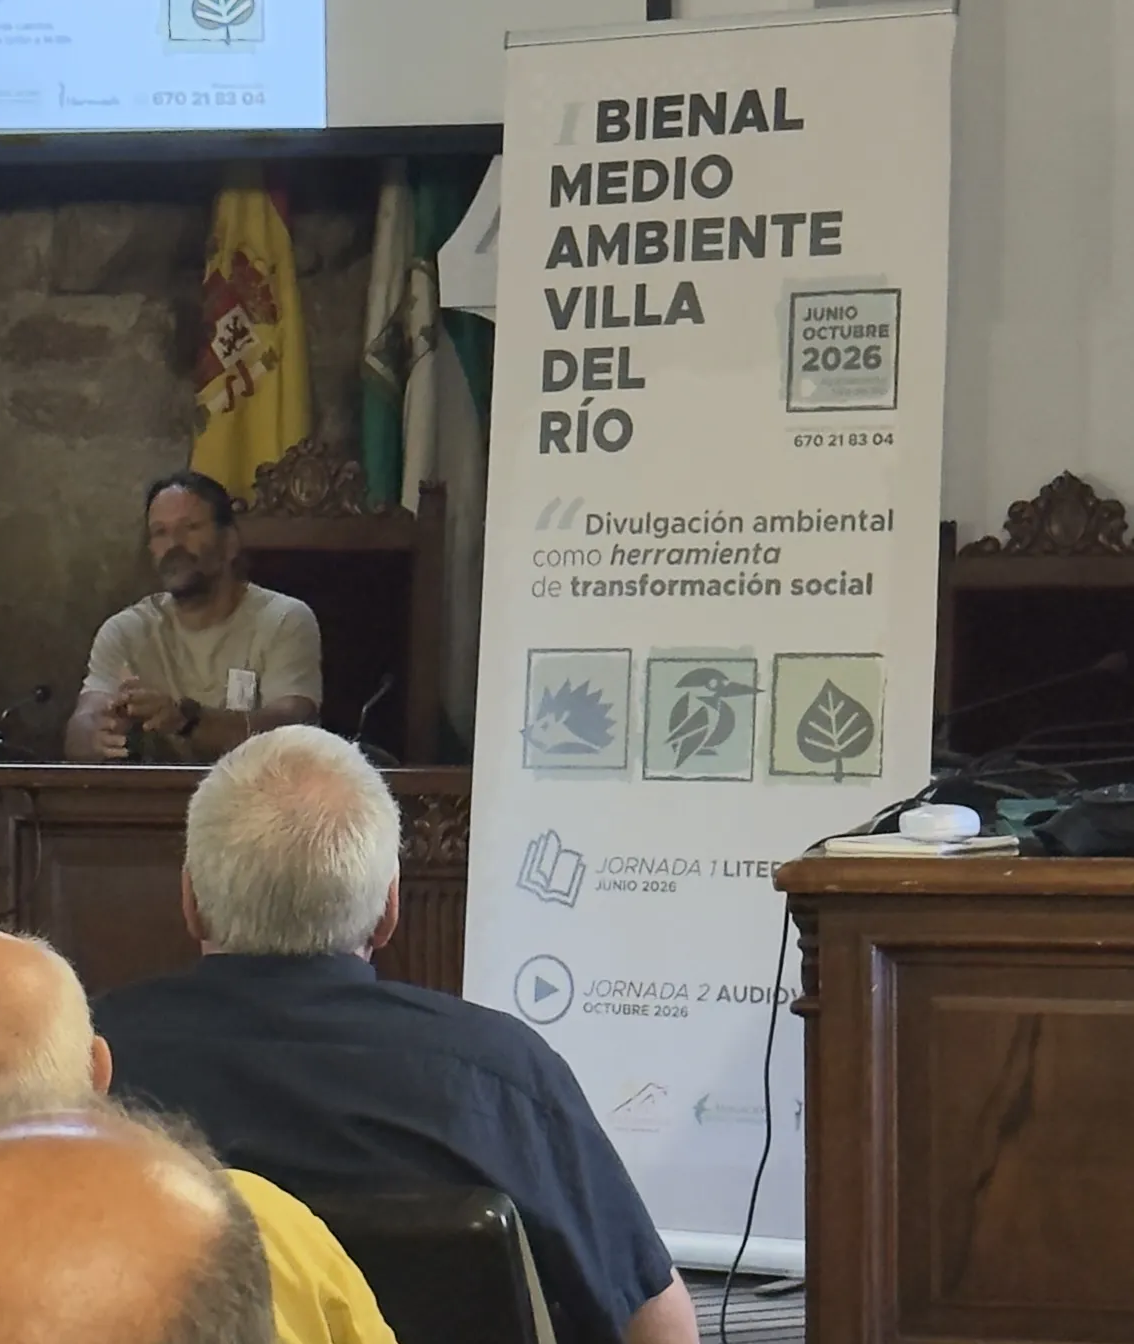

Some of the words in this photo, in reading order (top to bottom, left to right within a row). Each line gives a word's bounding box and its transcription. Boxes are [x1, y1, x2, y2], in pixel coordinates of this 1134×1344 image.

[151, 90, 187, 107] 670
[191, 90, 211, 106] 21
[214, 90, 237, 106] 83
[240, 90, 266, 106] 04
[595, 87, 805, 144] BIENAL
[549, 154, 734, 208] MEDIO
[545, 211, 844, 270] AMBIENTE
[543, 281, 706, 331] VILLA
[802, 305, 859, 322] JUNIO
[802, 323, 891, 341] OCTUBRE
[541, 347, 646, 393] DEL
[801, 344, 883, 373] 2026
[539, 396, 634, 455] RÍO
[793, 434, 824, 448] 670
[828, 434, 844, 447] 21
[848, 433, 868, 447] 83
[872, 432, 895, 446] 04
[585, 511, 744, 540] Divulgación
[752, 508, 894, 533] ambiental
[532, 546, 603, 568] como
[609, 542, 782, 567] herramienta
[530, 575, 563, 598] de
[570, 571, 783, 598] transformación
[790, 571, 874, 596] social
[594, 856, 702, 877] JORNADA
[709, 859, 717, 877] 1
[595, 880, 638, 892] JUNIO
[642, 880, 677, 893] 2026
[582, 979, 690, 1001] JORNADA
[696, 983, 711, 1002] 2
[582, 1001, 649, 1016] OCTUBRE
[654, 1005, 689, 1018] 2026
